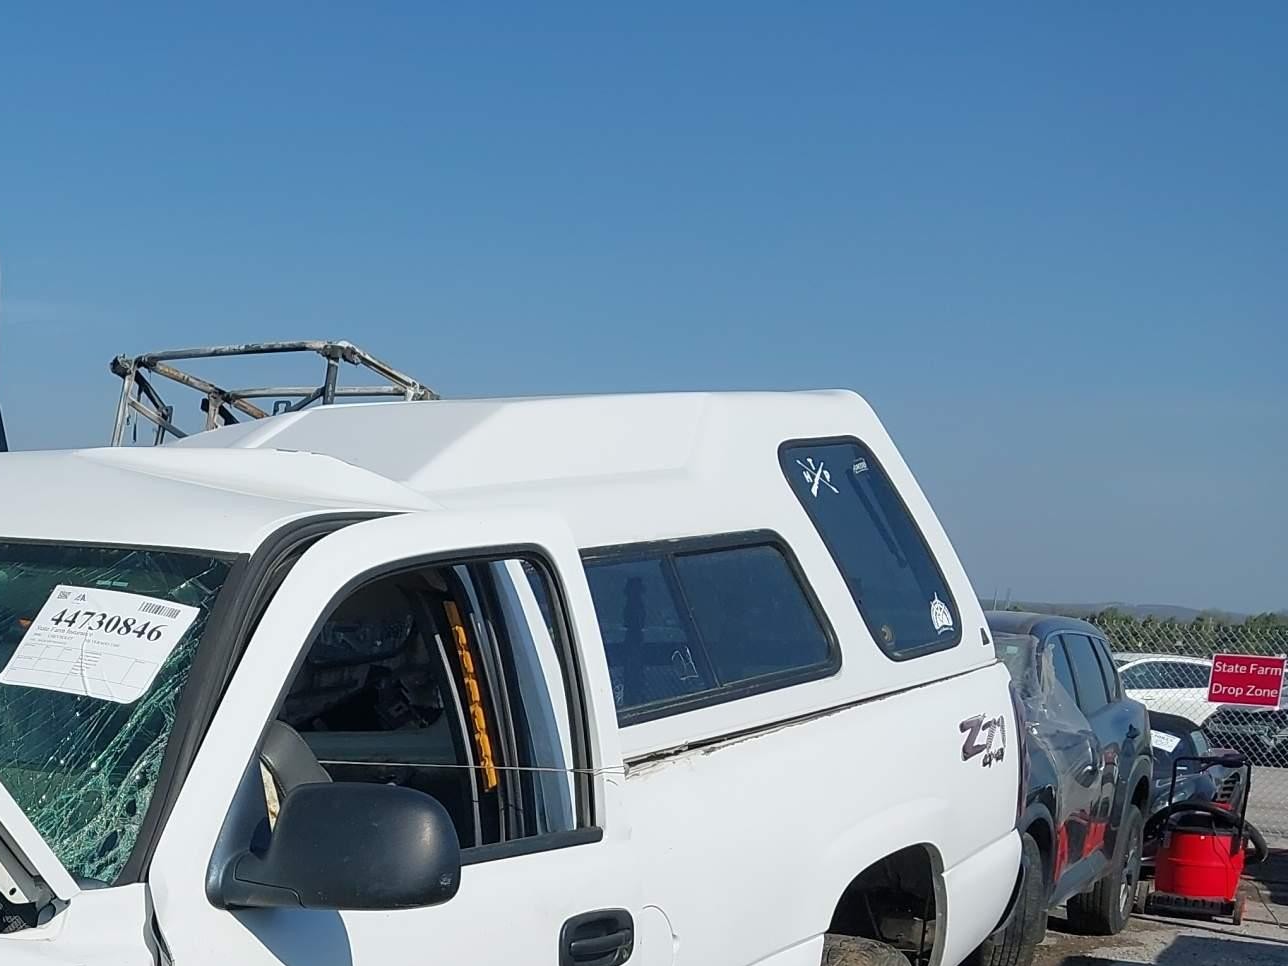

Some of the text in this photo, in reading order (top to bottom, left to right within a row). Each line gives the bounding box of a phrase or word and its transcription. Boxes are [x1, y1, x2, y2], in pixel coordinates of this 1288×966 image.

[51, 608, 168, 642] 44730846
[1214, 661, 1282, 676] State Farm
[1212, 682, 1278, 698] Drop Zone
[959, 713, 1006, 761] Z71
